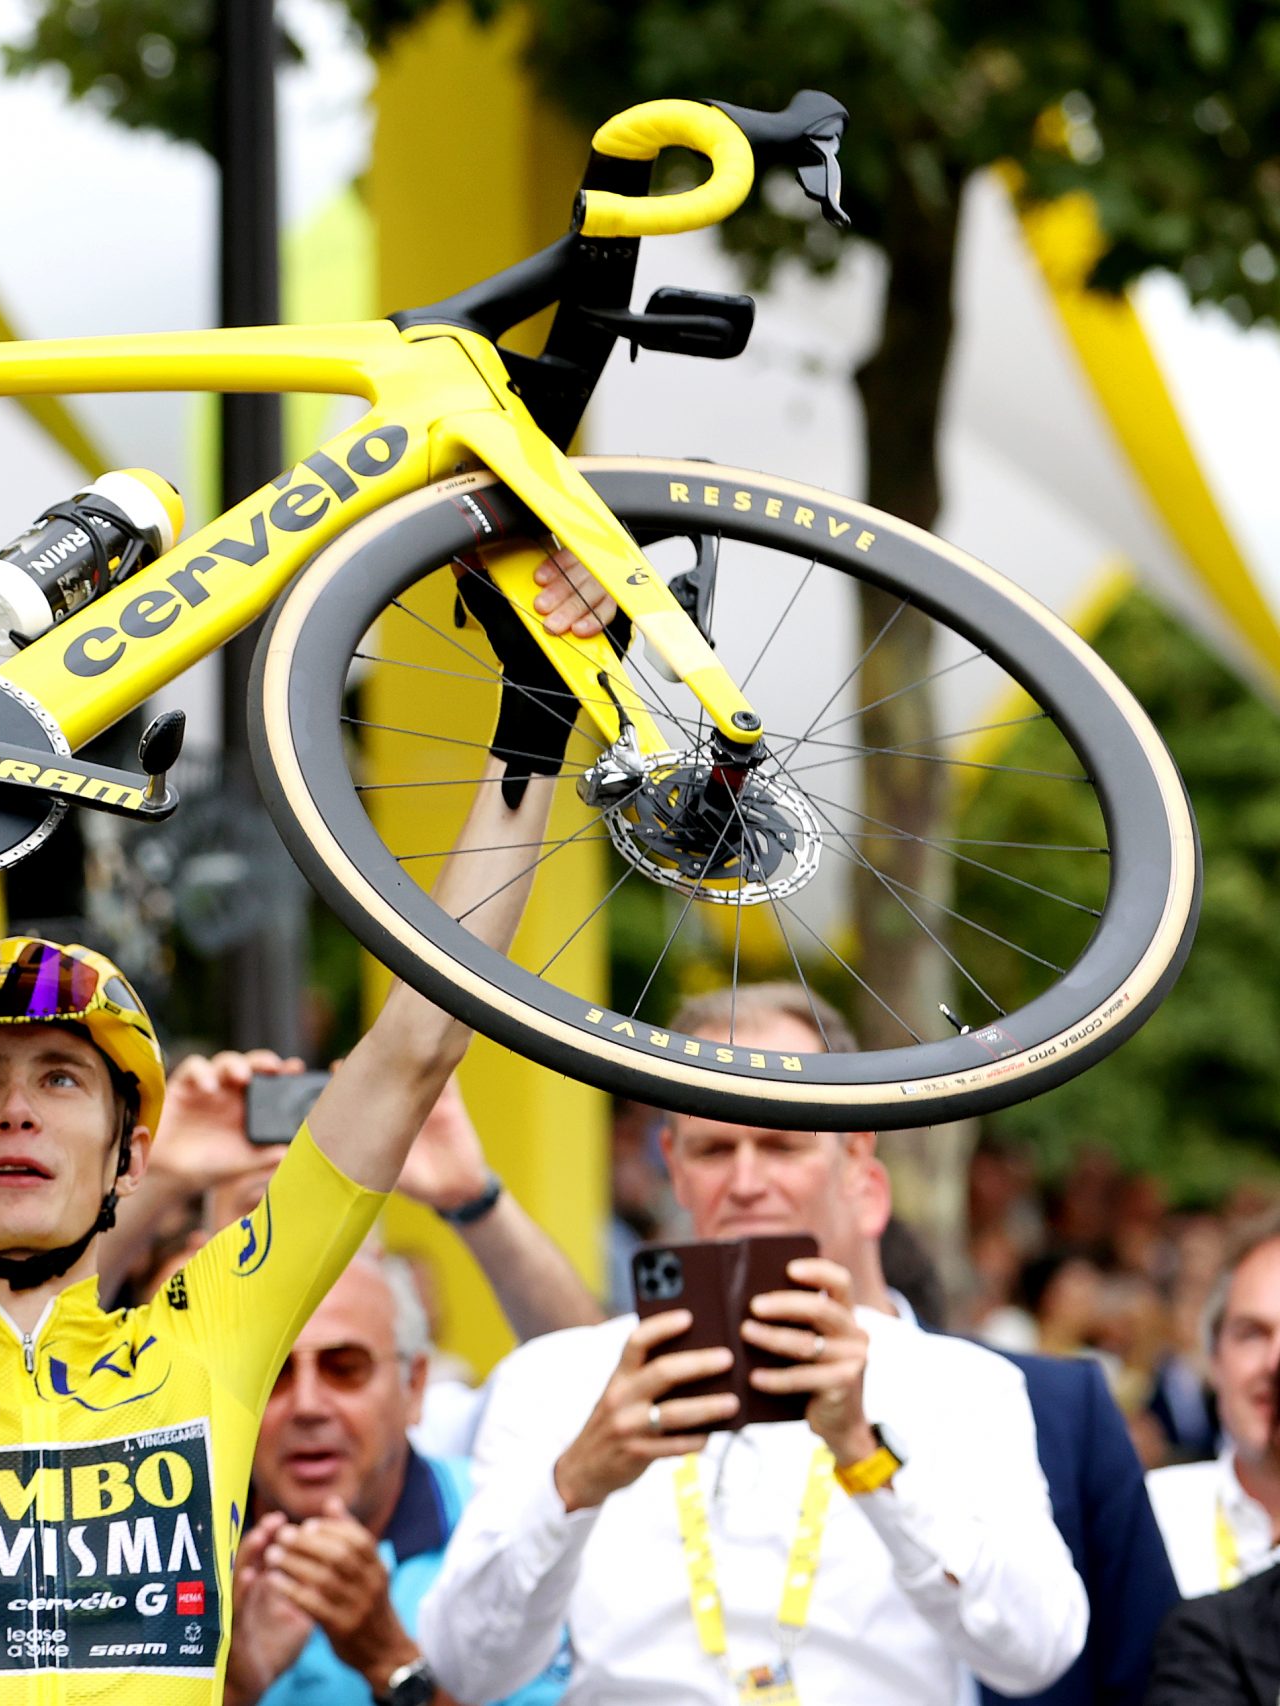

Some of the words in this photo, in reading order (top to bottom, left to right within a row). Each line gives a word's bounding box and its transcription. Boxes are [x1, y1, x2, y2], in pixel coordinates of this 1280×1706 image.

[669, 481, 876, 553] RESERVE
[584, 1008, 803, 1072] RESERVE
[135, 1425, 205, 1450] VINGEGAARD
[134, 1582, 170, 1617] G
[6, 1626, 67, 1643] lease
[88, 1642, 168, 1657] SRAM
